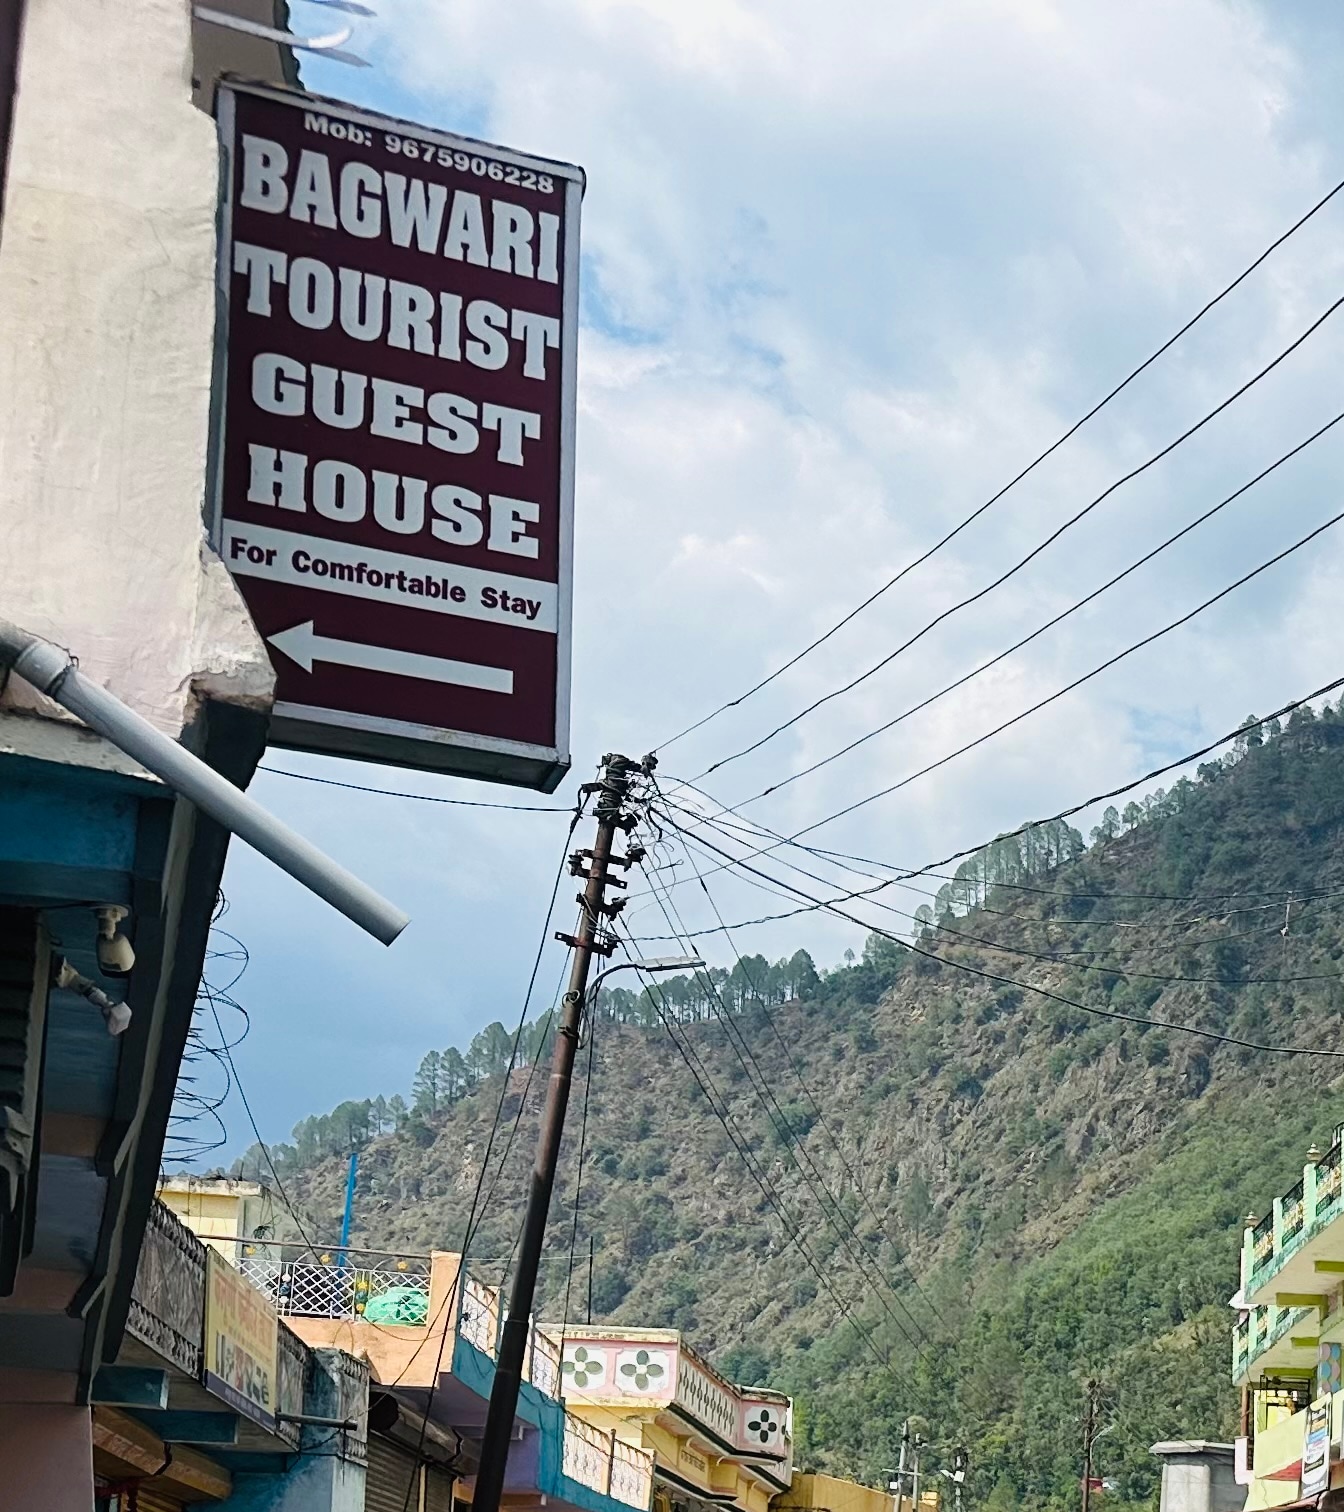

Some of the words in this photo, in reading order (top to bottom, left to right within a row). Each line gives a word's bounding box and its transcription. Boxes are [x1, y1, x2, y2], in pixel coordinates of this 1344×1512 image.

[240, 133, 559, 284] BAGWARI
[304, 113, 372, 147] Mob:
[385, 133, 554, 194] 9675906228
[233, 241, 559, 380] TOURIST
[251, 352, 540, 466] GUEST
[247, 443, 539, 559] HOUSE
[230, 537, 277, 566] For
[291, 550, 466, 602] Comfortable
[480, 587, 541, 620] Stay
